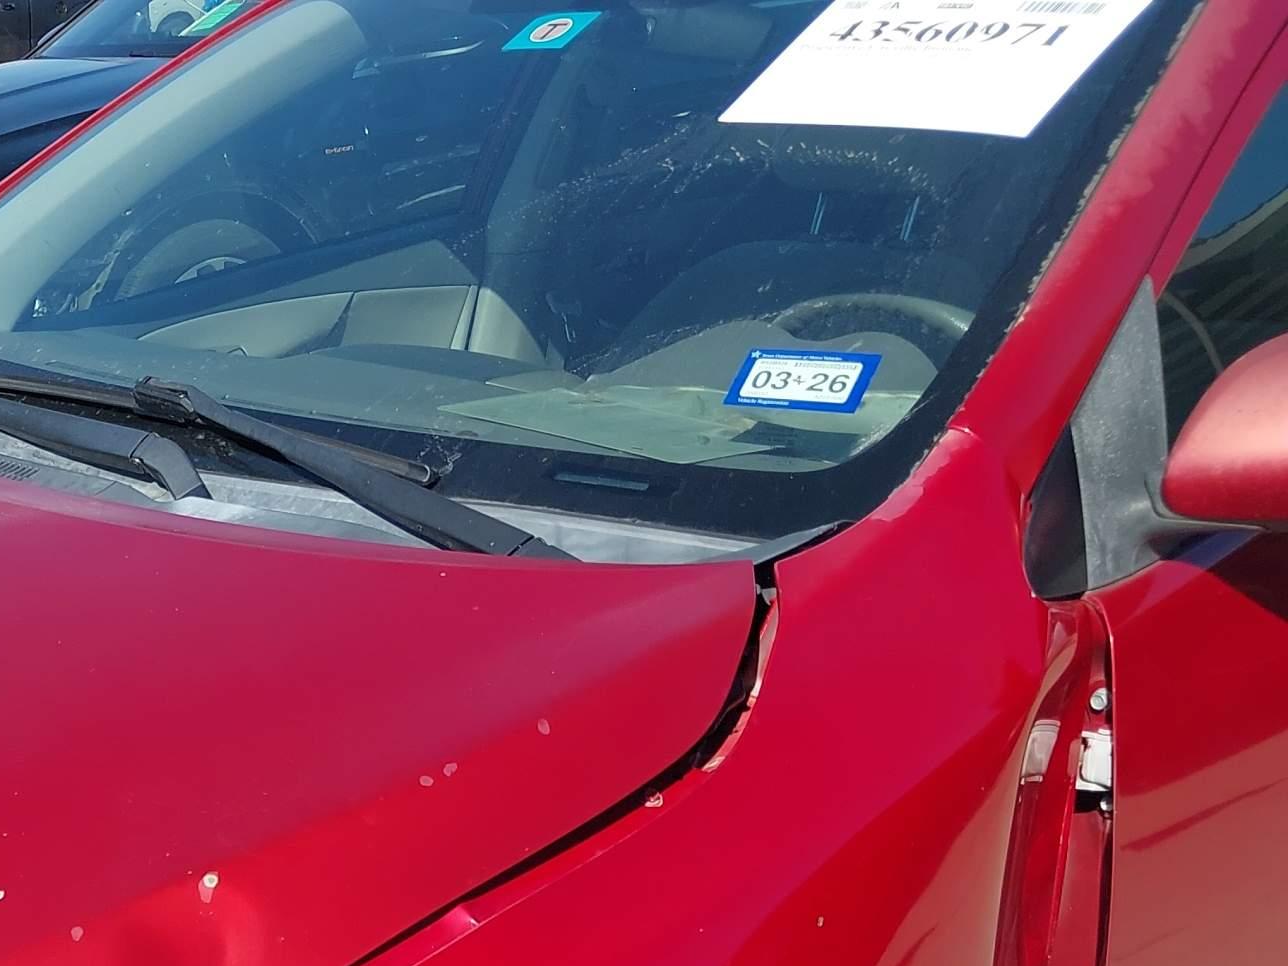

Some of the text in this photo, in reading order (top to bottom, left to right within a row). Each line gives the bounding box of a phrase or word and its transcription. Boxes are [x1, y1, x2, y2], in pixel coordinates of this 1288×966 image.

[540, 22, 569, 40] T
[829, 19, 1070, 46] 43560971
[751, 370, 850, 393] 03 26
